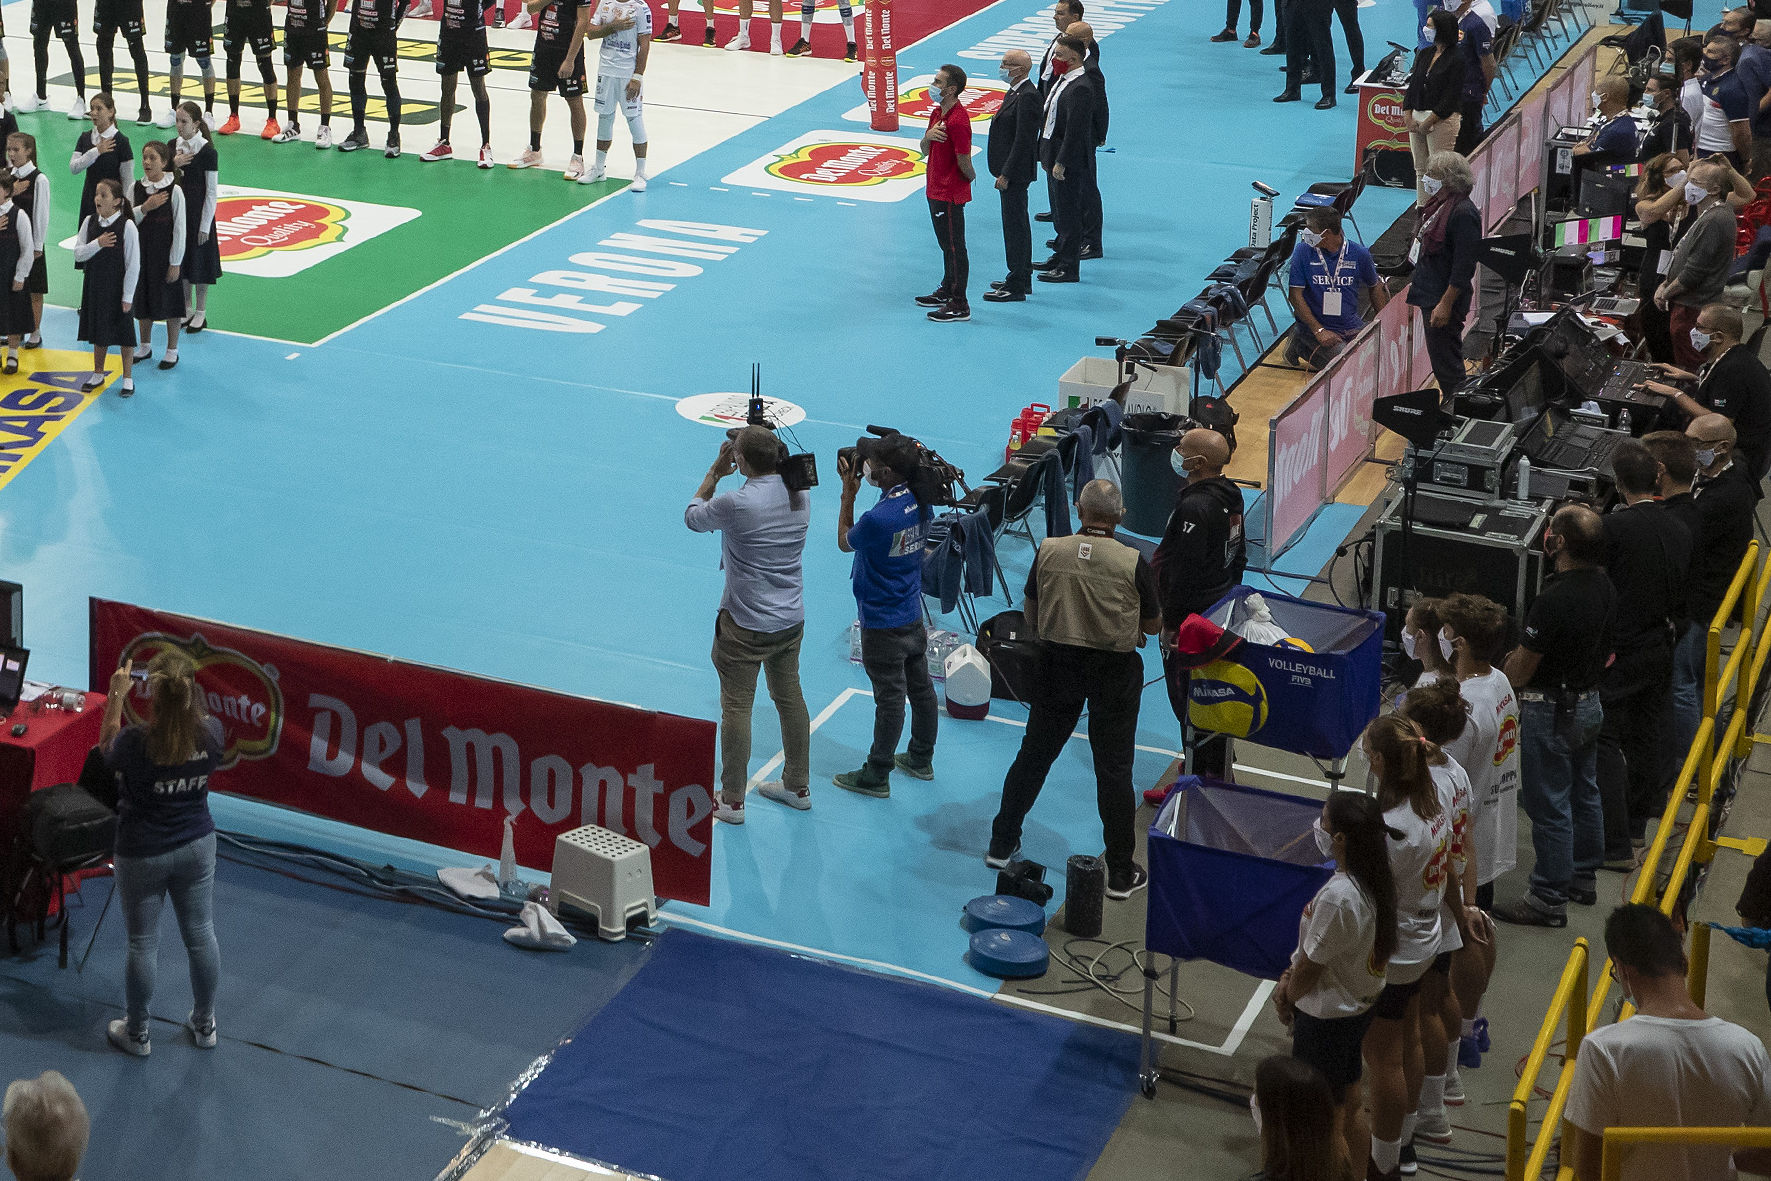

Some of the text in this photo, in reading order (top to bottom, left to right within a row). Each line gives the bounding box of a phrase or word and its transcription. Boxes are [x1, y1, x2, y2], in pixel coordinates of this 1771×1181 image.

[882, 8, 891, 50] Del Monte
[866, 36, 874, 50] Del
[868, 71, 876, 100] Monte
[886, 71, 895, 114] Del Monte
[1374, 103, 1389, 115] Del
[831, 145, 889, 175] Monte
[1252, 203, 1260, 227] Project
[240, 219, 317, 249] Quality
[458, 219, 769, 334] VERONA
[1393, 405, 1424, 416] SHURE
[1268, 657, 1336, 680] VOLLEYBALL
[1291, 674, 1312, 685] FIVB
[1193, 682, 1236, 698] MIKASA
[152, 774, 208, 795] STAFF
[307, 693, 715, 859] Del Monte
